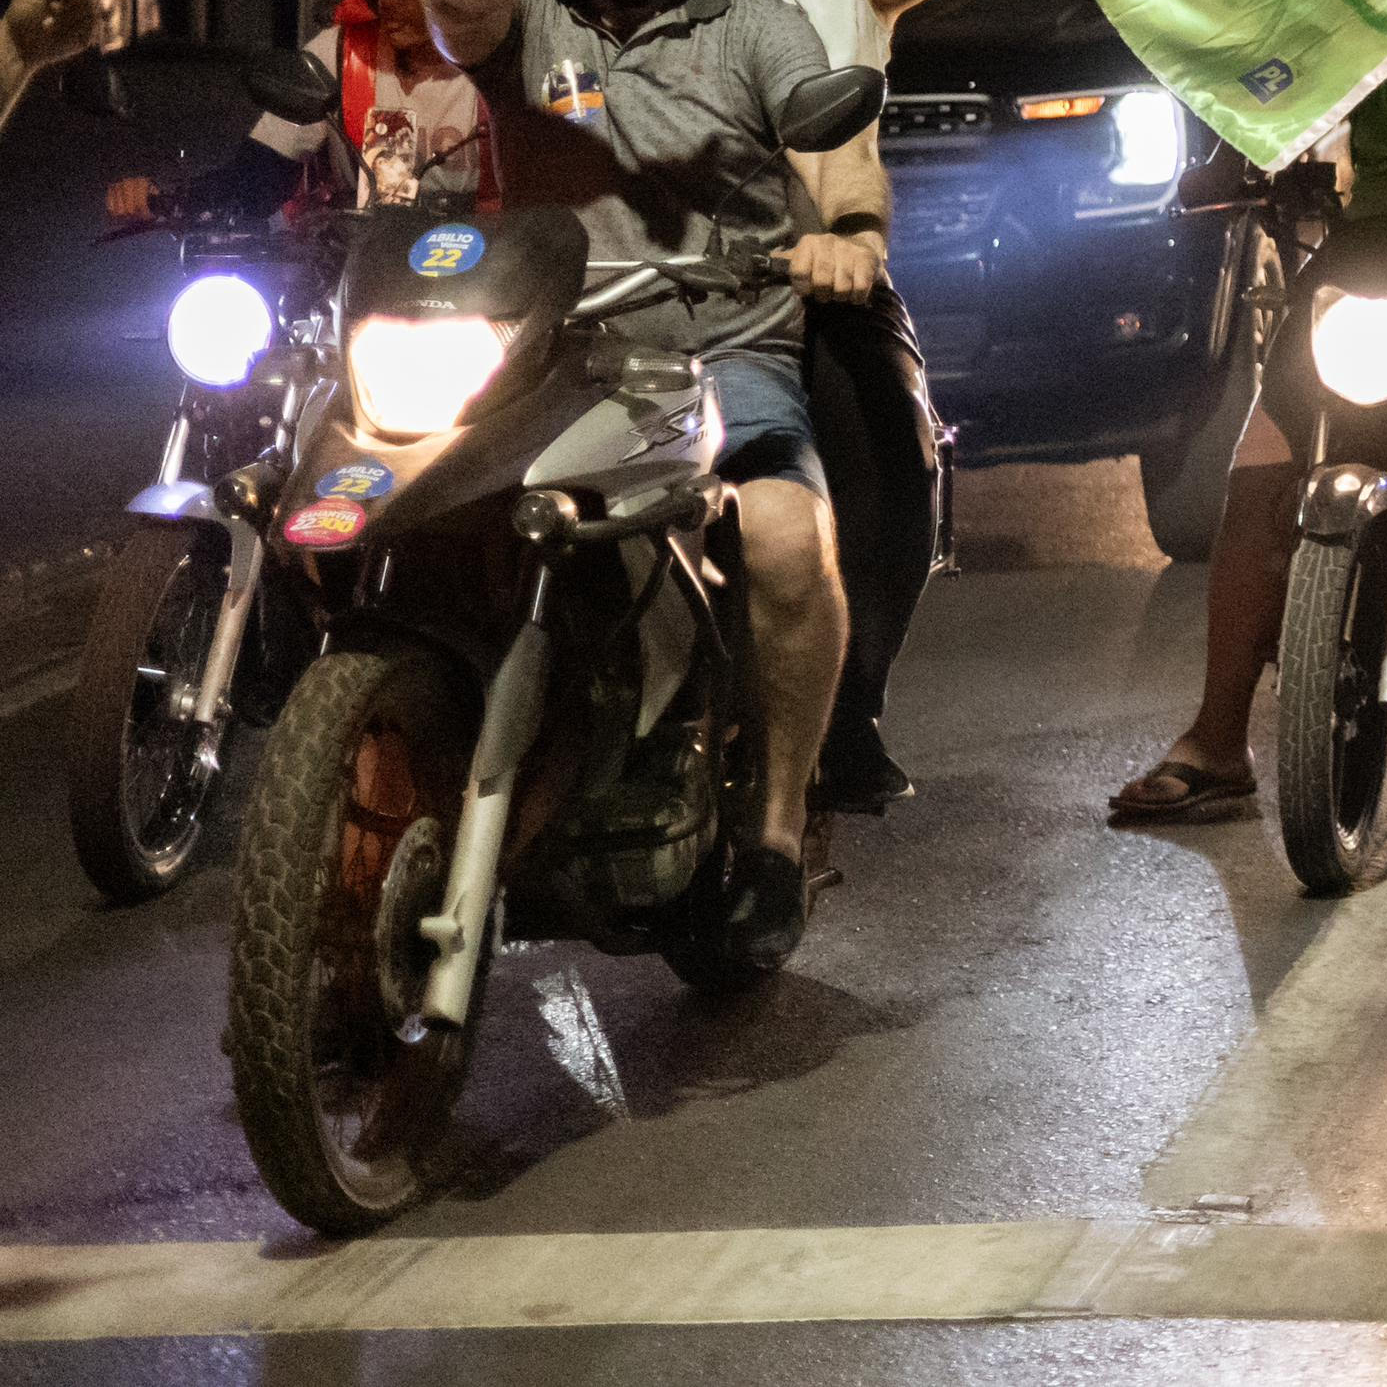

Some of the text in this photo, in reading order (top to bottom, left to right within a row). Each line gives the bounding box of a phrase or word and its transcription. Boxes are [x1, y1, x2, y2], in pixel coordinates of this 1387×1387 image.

[1253, 65, 1289, 92] PL
[426, 233, 474, 244] ABILIO
[422, 248, 463, 269] 22
[335, 466, 386, 477] ABILIO
[330, 477, 373, 494] 22
